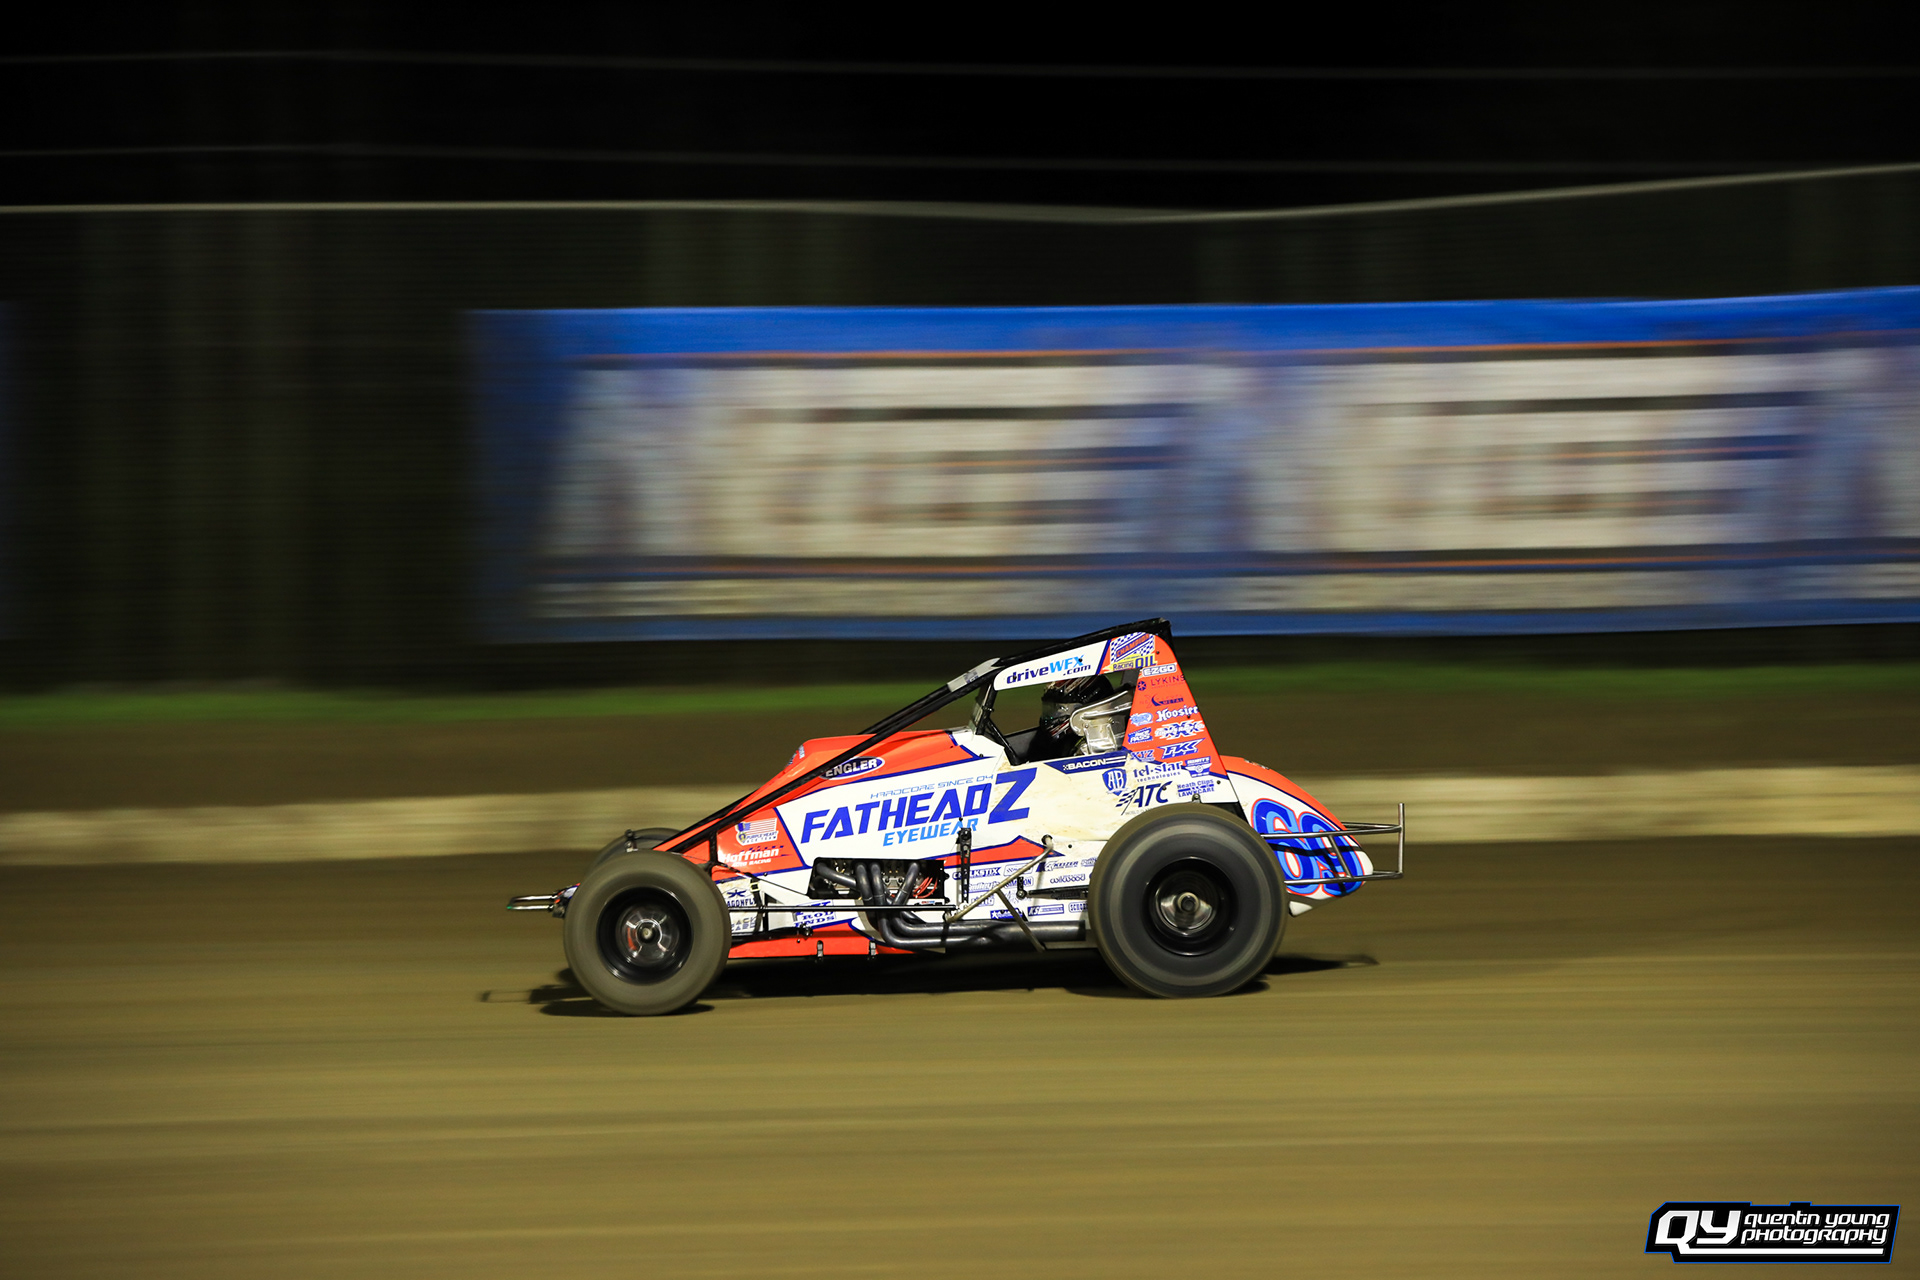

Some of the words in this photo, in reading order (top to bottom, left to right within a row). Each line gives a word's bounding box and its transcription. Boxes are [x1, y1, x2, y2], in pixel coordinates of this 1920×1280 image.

[1135, 655, 1156, 669] OIL
[1063, 664, 1091, 676] .com
[1143, 663, 1176, 677] EZGO
[1150, 675, 1185, 686] LYKINS
[1156, 704, 1198, 722] Hoosier
[825, 758, 878, 777] ENGLER
[1067, 758, 1106, 770] BACON
[870, 783, 935, 799] HARDCORE
[937, 776, 974, 788] SINCE
[976, 774, 995, 783] 04
[883, 817, 979, 847] EYEWEAR
[720, 848, 780, 865] Hoffman
[749, 858, 772, 866] RACING
